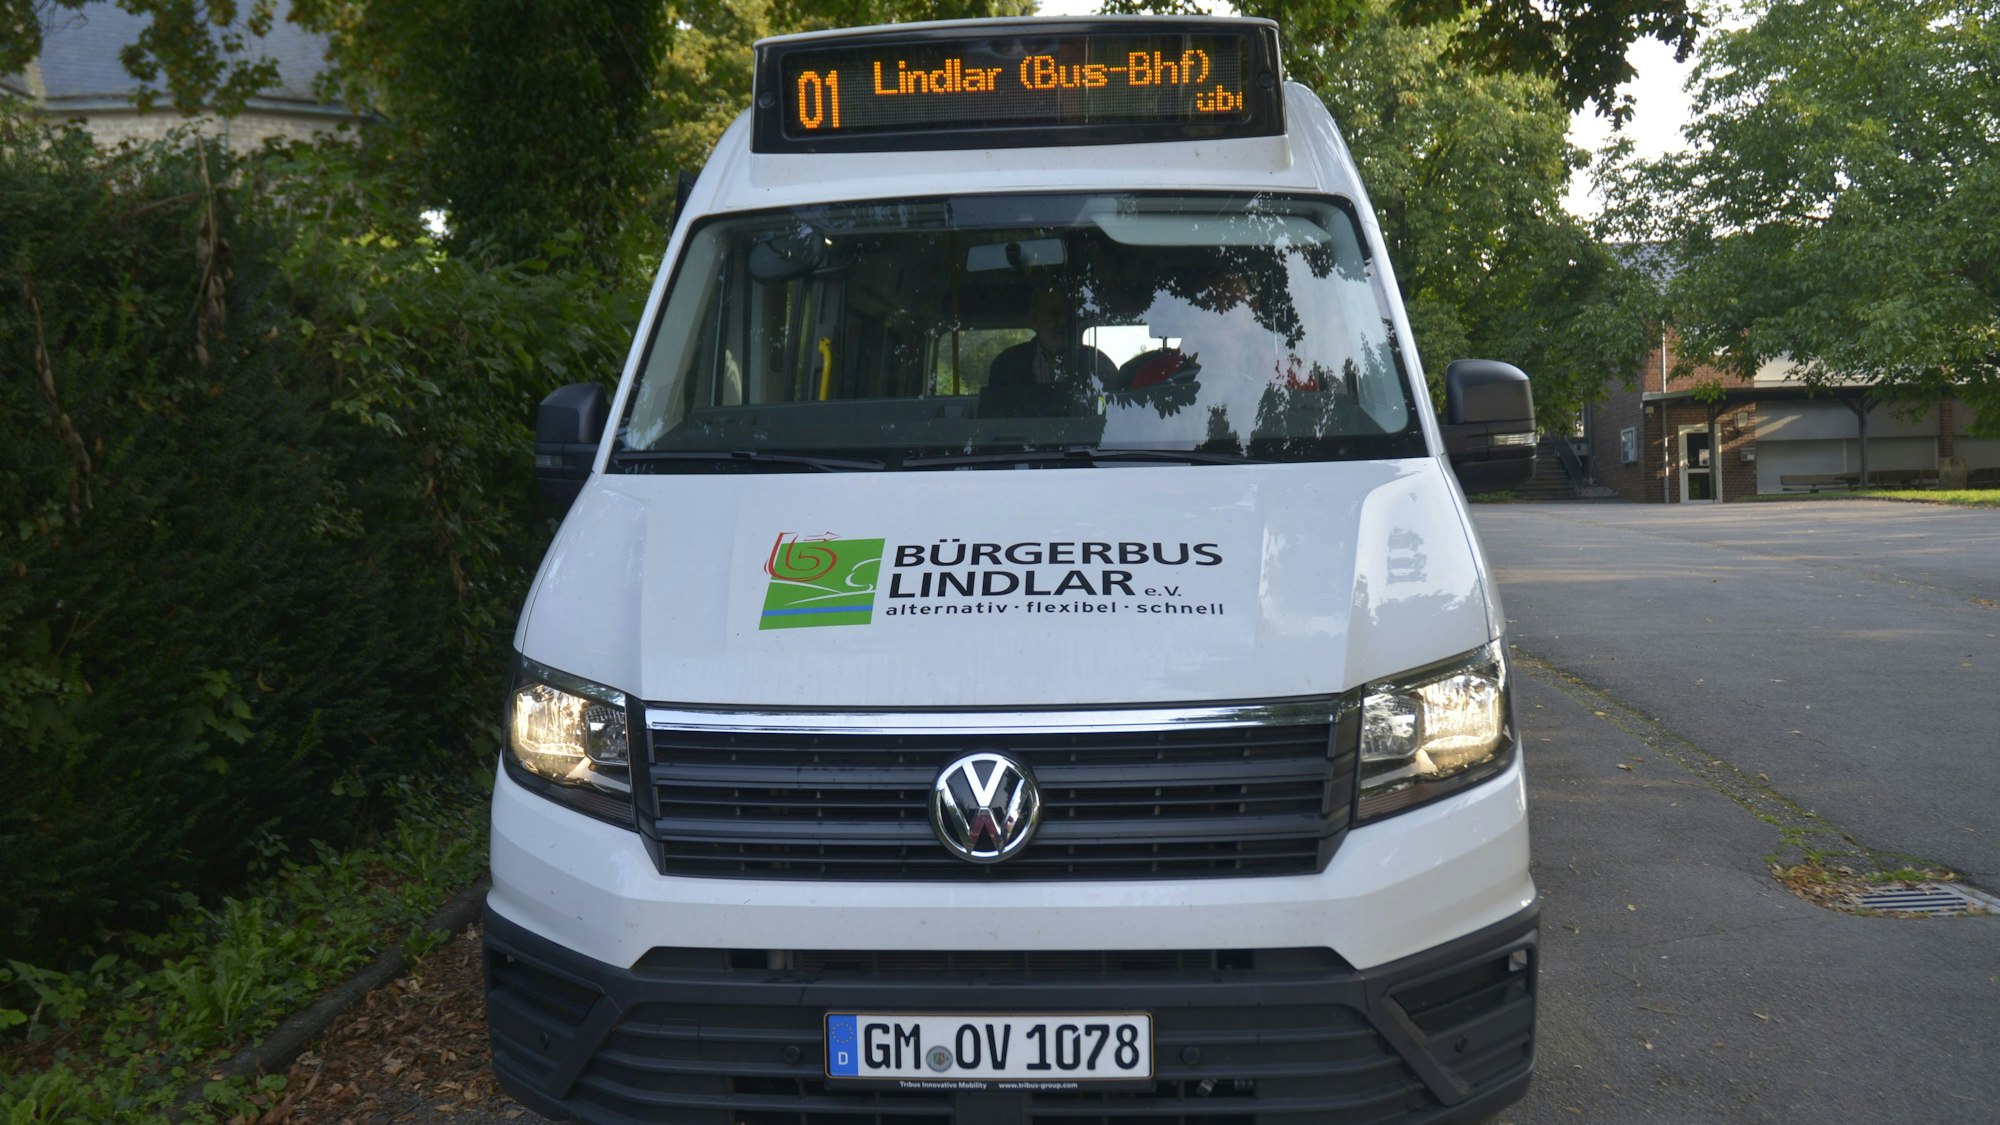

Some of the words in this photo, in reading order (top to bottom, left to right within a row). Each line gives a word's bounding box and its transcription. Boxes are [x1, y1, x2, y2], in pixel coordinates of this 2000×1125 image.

[873, 58, 1002, 96] Lindlar
[1019, 48, 1209, 90] (Bus-Bhf)
[798, 70, 840, 129] 01
[894, 539, 1223, 568] BÜRGERBUS
[888, 570, 1136, 598] LINDLAR
[1144, 585, 1182, 597] e.V.
[885, 602, 1007, 616] alternativ
[1027, 601, 1116, 614] flexibel
[1137, 603, 1224, 615] schnell
[838, 1051, 848, 1065] D
[864, 1023, 921, 1069] GM
[955, 1024, 1011, 1070] OV
[1026, 1024, 1140, 1071] 1078
[922, 1081, 957, 1089] Innovative
[959, 1081, 987, 1090] Mobility
[999, 1081, 1078, 1091] www.tribus-group.com
